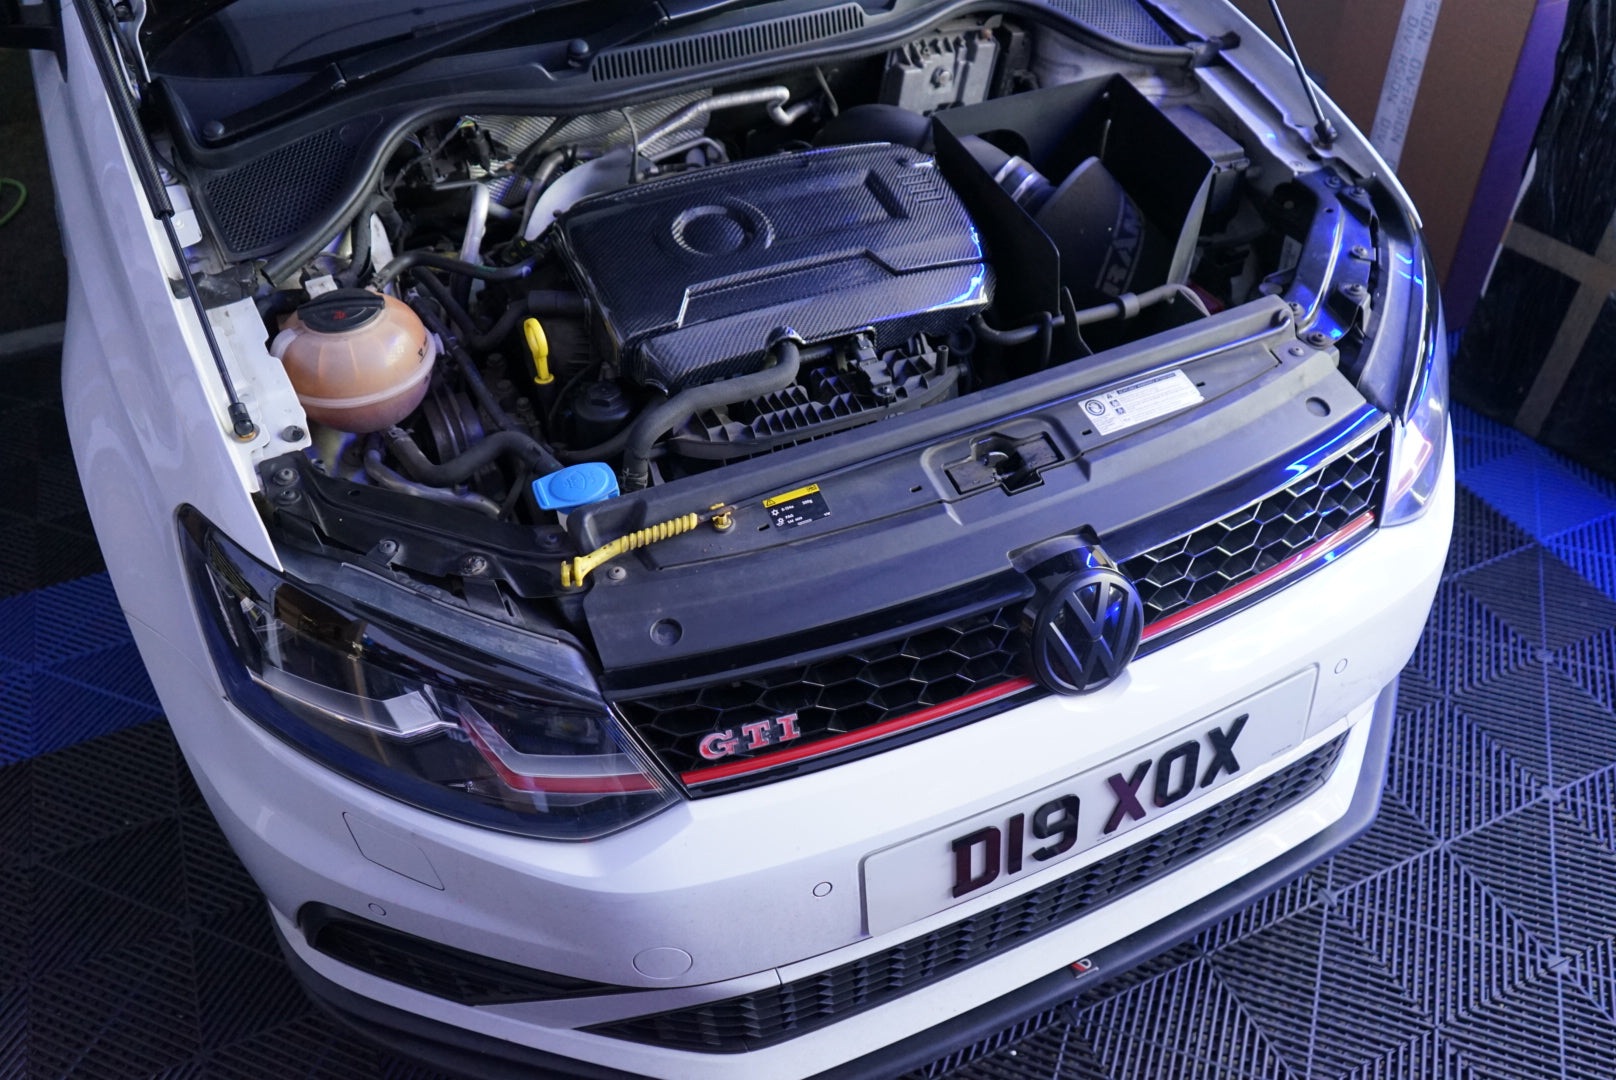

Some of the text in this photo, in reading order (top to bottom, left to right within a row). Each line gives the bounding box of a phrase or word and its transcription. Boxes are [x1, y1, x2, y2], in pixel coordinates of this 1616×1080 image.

[1387, 15, 1419, 105] DIVERSION
[1391, 57, 1422, 144] DIVERSION
[699, 712, 801, 760] GTI
[951, 713, 1250, 899] D19 XOX
